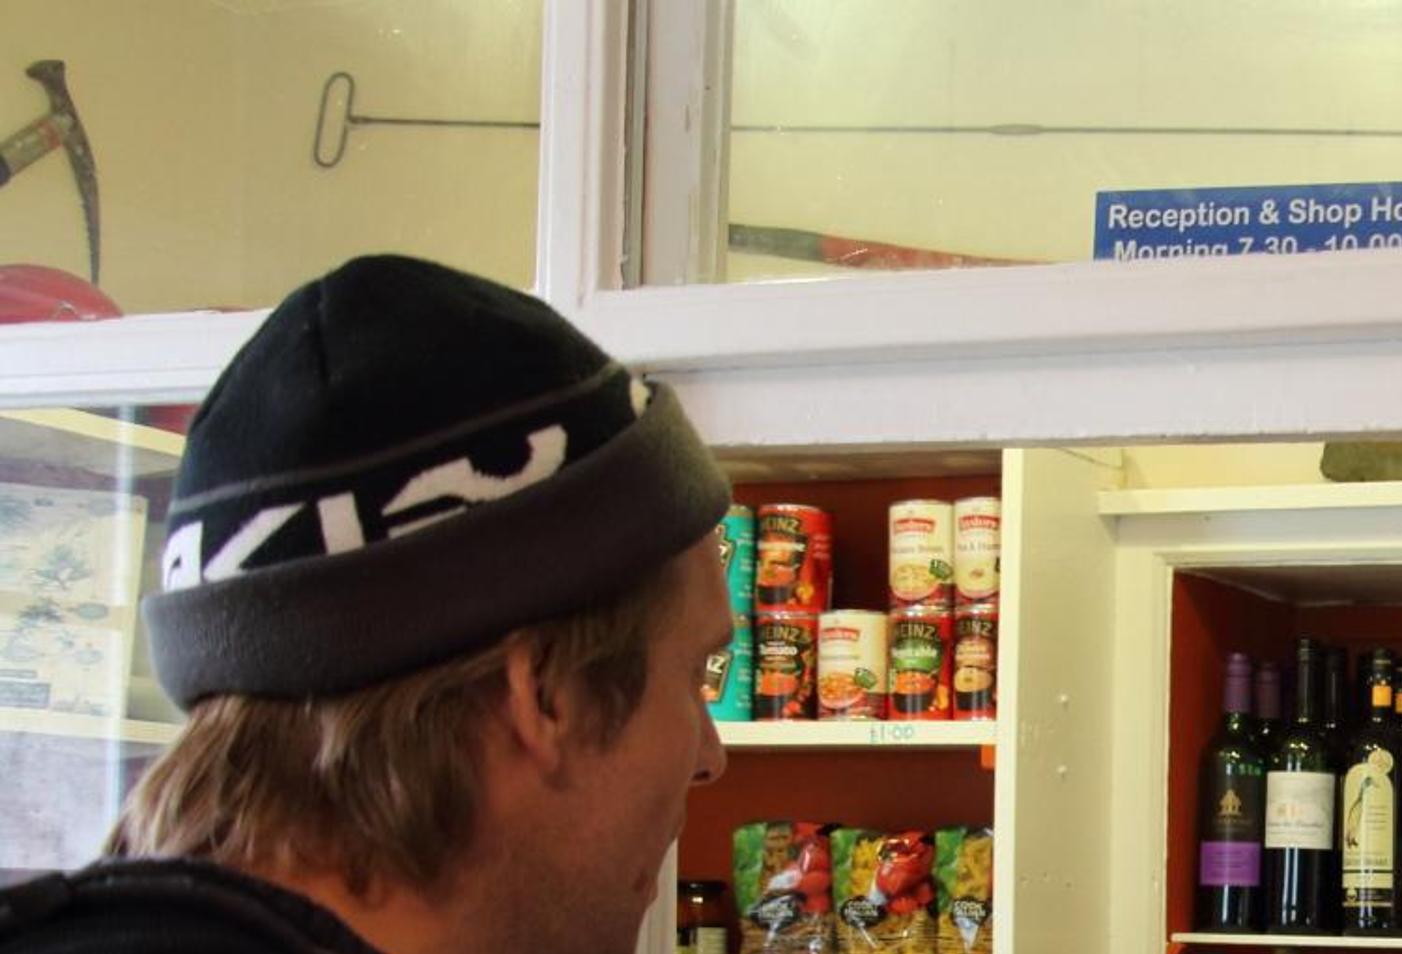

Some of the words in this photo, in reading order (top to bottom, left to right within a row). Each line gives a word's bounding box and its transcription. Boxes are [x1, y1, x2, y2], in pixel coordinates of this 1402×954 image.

[1108, 202, 1250, 233] Reception
[1260, 201, 1280, 225] &
[1289, 199, 1362, 229] Shop
[1239, 236, 1298, 255] 730
[896, 623, 936, 640] EINZ
